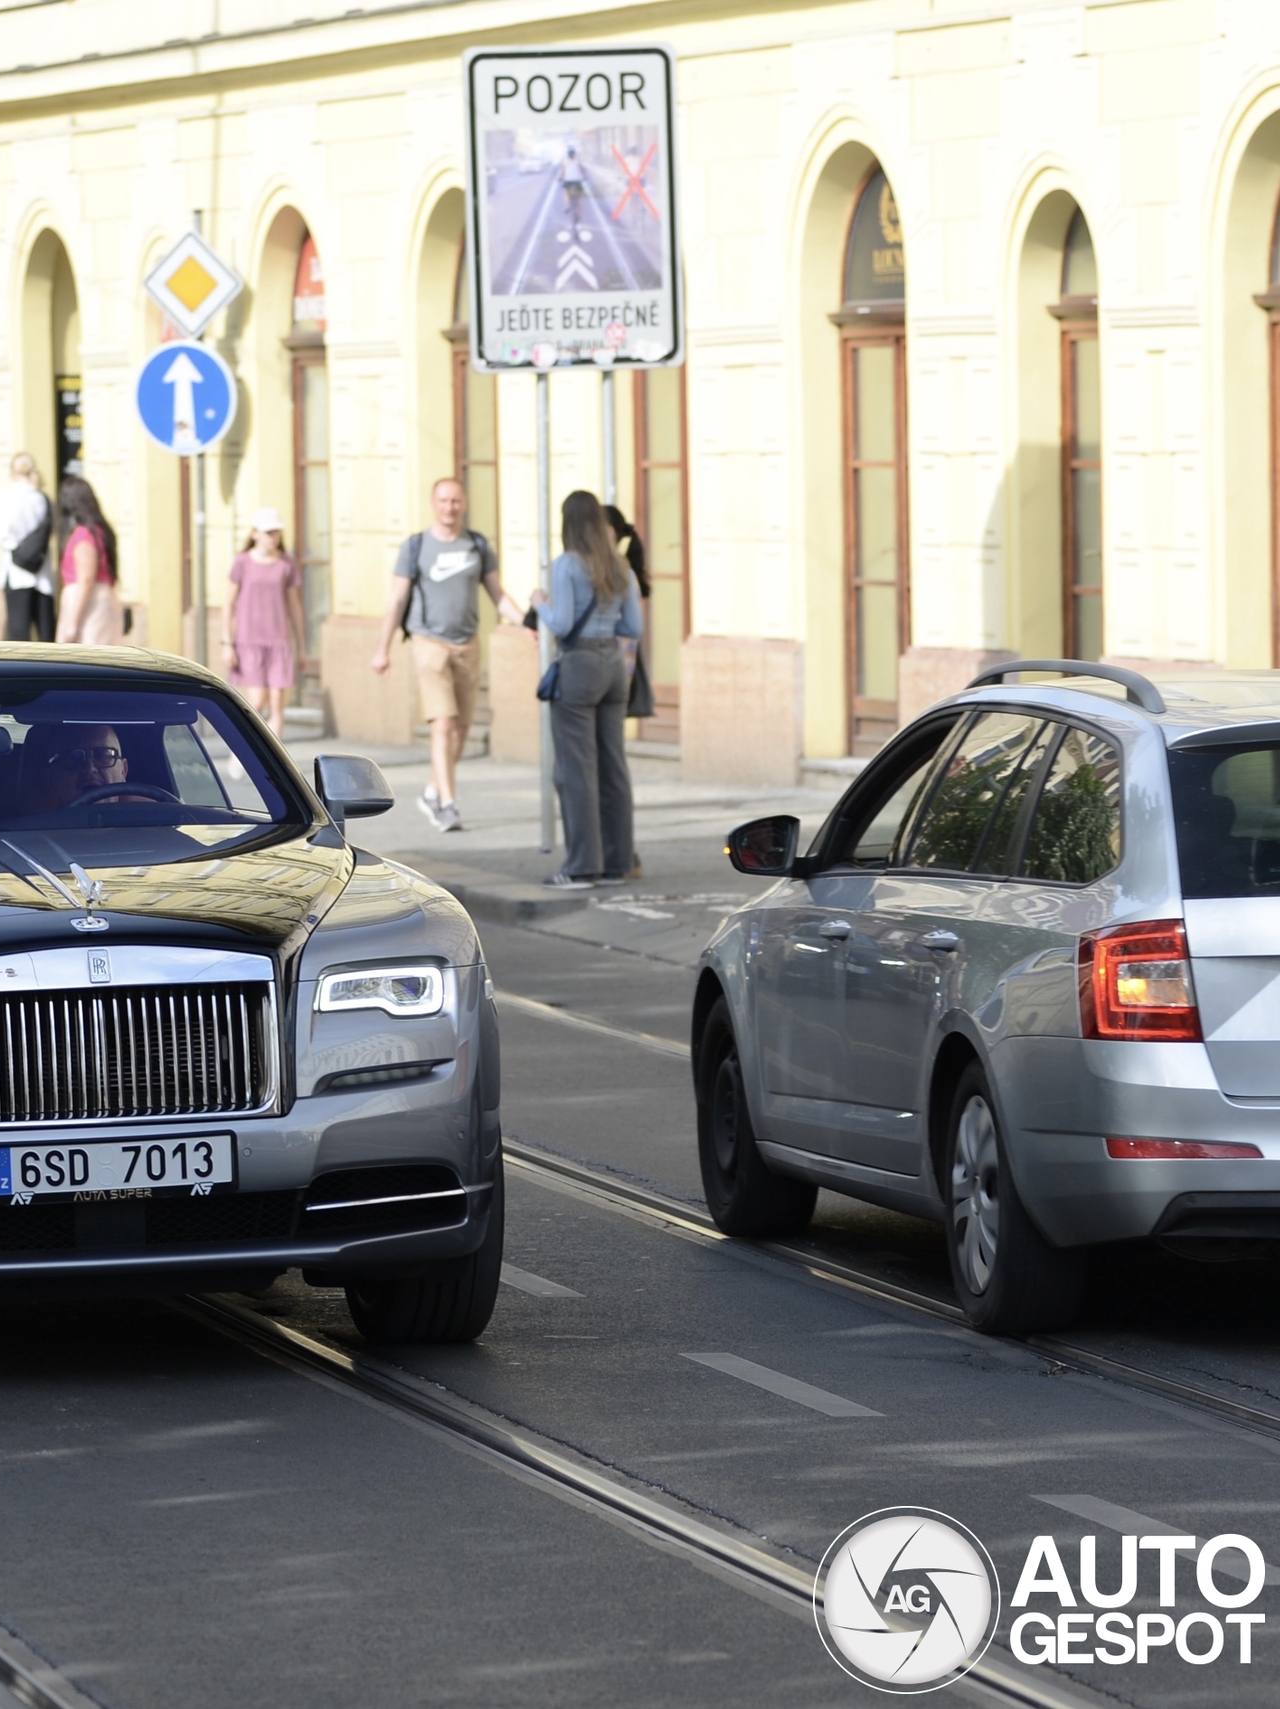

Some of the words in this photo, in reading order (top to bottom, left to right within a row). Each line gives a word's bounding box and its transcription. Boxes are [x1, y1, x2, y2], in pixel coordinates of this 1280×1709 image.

[493, 71, 647, 115] POZOR
[497, 304, 554, 332] JEĎTE
[562, 300, 661, 329] BEZPEČNĚ
[20, 1149, 89, 1188] 6SD
[121, 1141, 213, 1183] 7013
[110, 1188, 153, 1200] SUPER
